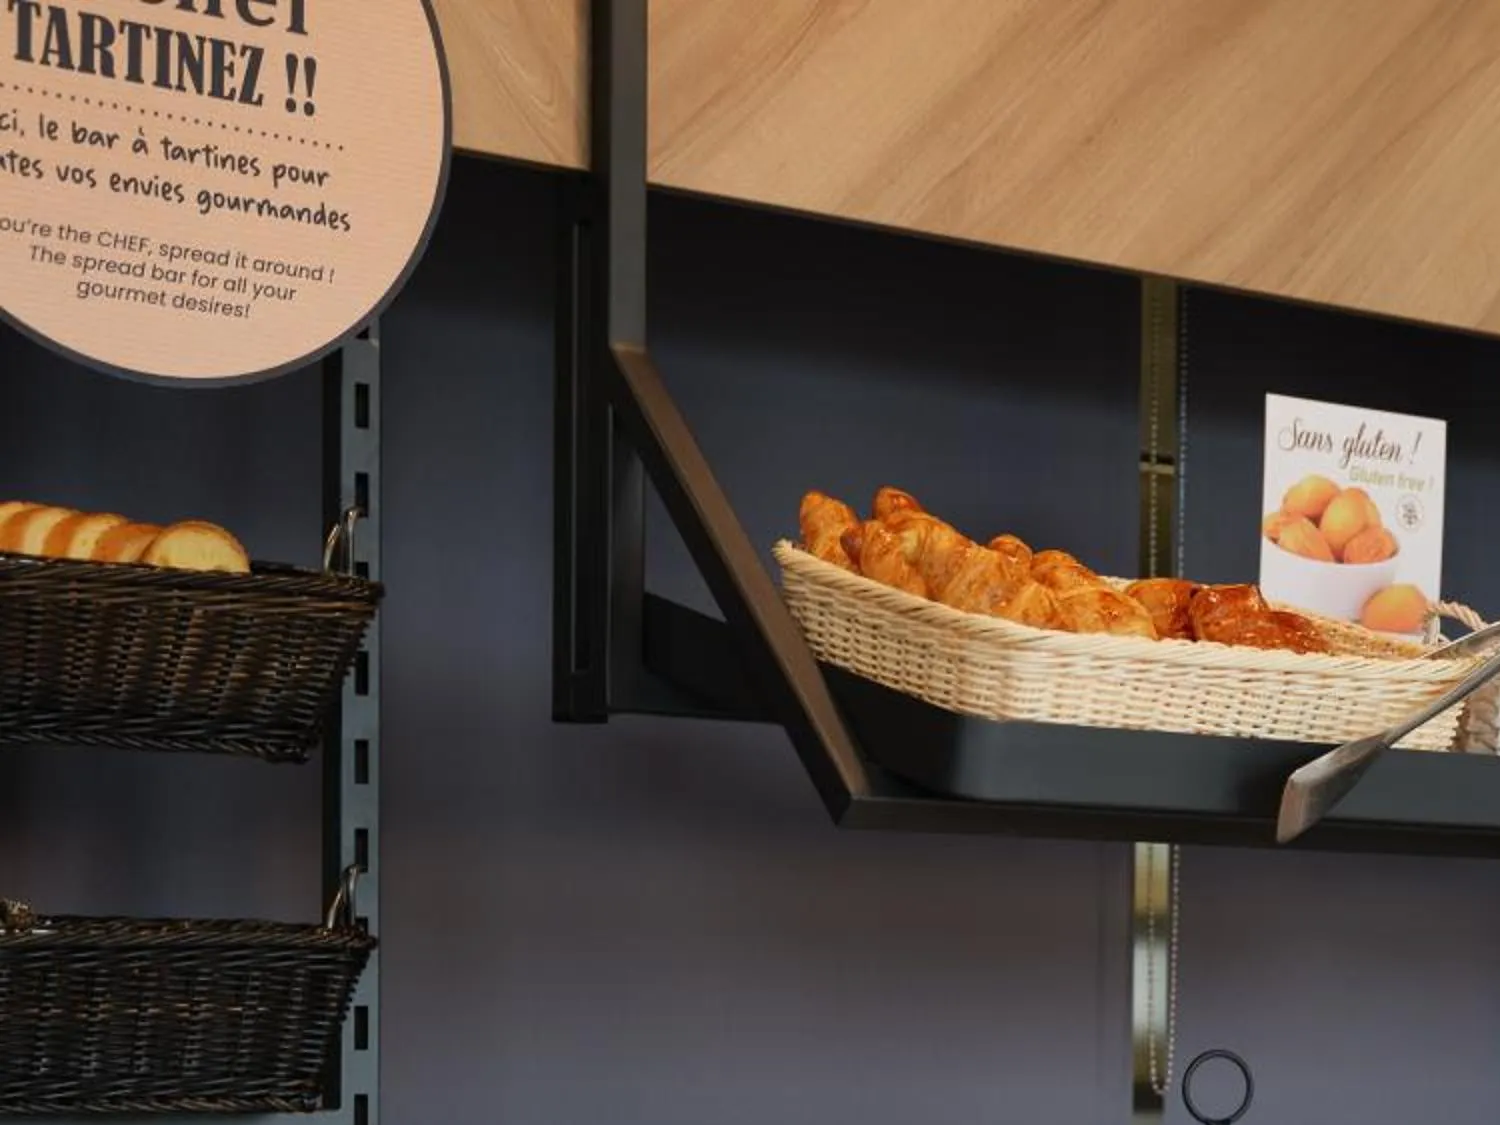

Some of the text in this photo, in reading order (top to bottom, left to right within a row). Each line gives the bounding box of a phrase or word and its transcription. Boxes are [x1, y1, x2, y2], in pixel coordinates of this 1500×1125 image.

[8, 0, 264, 106] TARTINEZ
[285, 53, 316, 116] !!
[0, 109, 329, 188] ci, le bar à tartines pour
[0, 150, 351, 231] tes vos envies gourmandes
[0, 217, 51, 237] ou're
[58, 224, 91, 243] the
[97, 231, 152, 256] CHEF,
[159, 243, 230, 266] spread
[235, 252, 248, 268] it
[253, 258, 324, 281] around
[31, 245, 297, 300] The spread bar for all your
[77, 281, 251, 318] gourmet desires!
[1278, 416, 1333, 453] Sans
[1339, 421, 1403, 469] gluten
